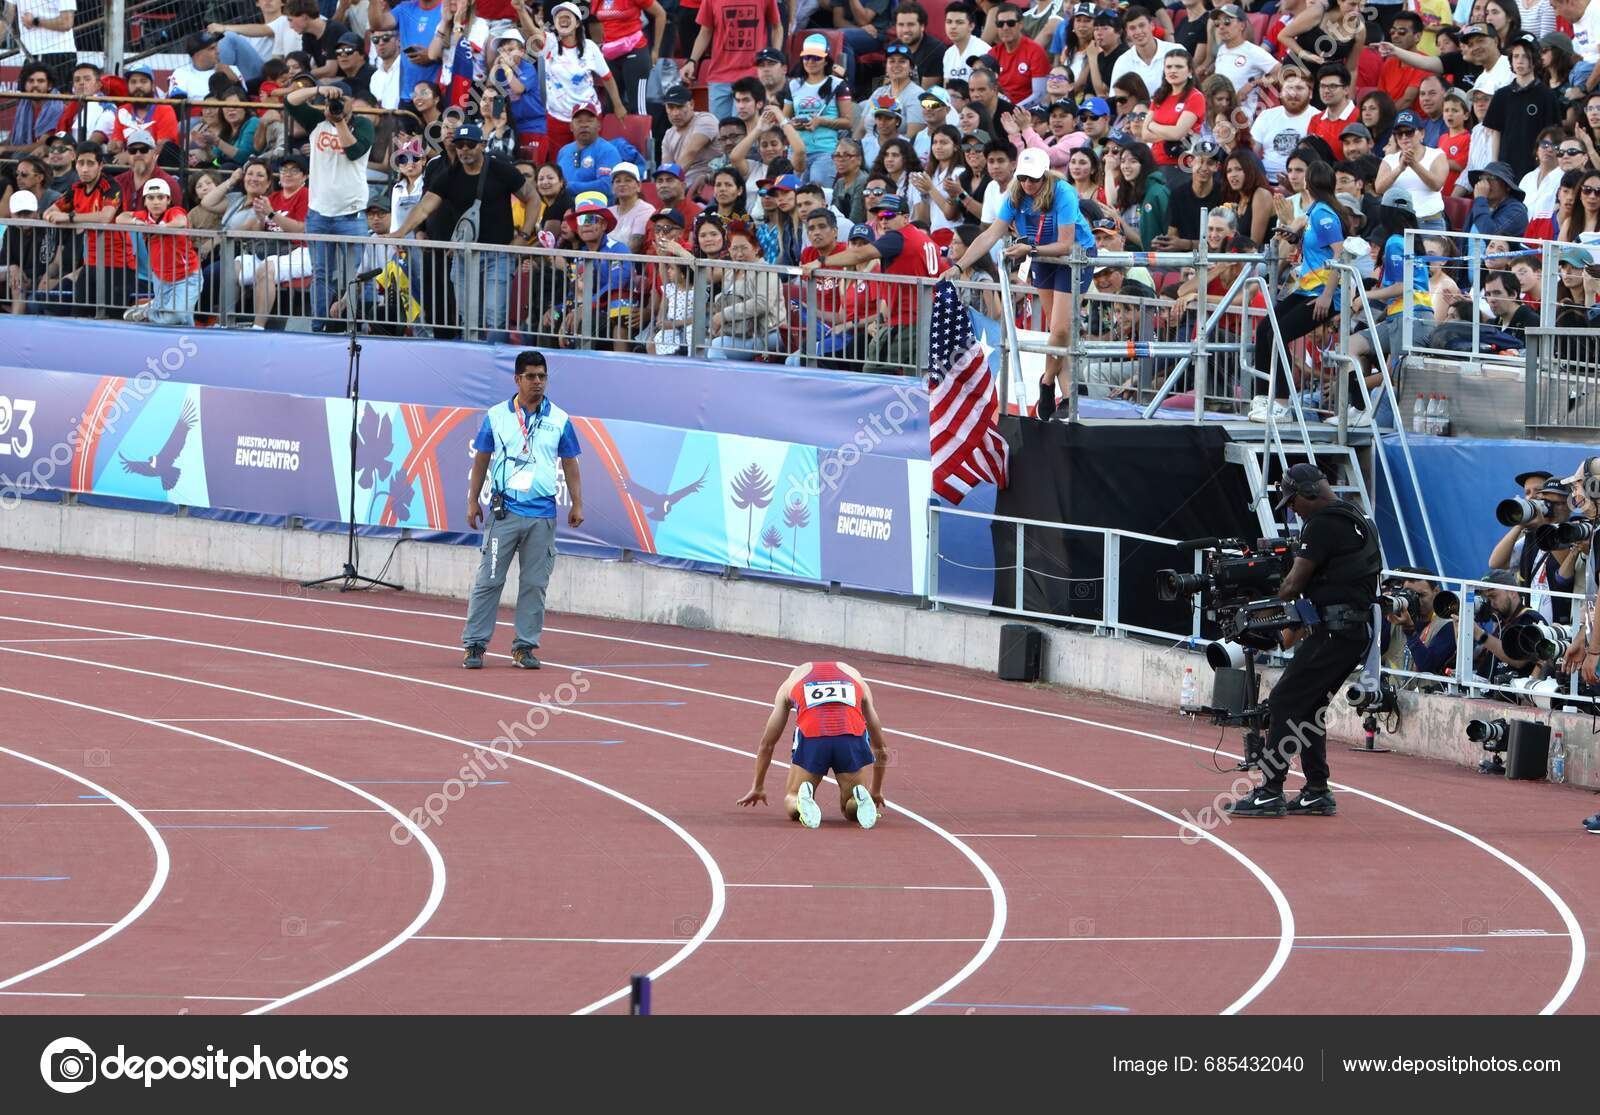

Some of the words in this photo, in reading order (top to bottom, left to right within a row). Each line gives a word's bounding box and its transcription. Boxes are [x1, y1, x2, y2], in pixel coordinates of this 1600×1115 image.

[923, 241, 939, 275] 10
[237, 435, 267, 449] NUESTRO
[267, 438, 290, 451] PUNTO
[290, 440, 300, 452] DE
[235, 447, 300, 471] ENCUENTRO
[840, 501, 866, 517] NUESTRO
[865, 504, 884, 519] PUNTO
[884, 508, 893, 521] DE
[837, 515, 891, 541] ENCUENTRO
[811, 687, 847, 700] 621
